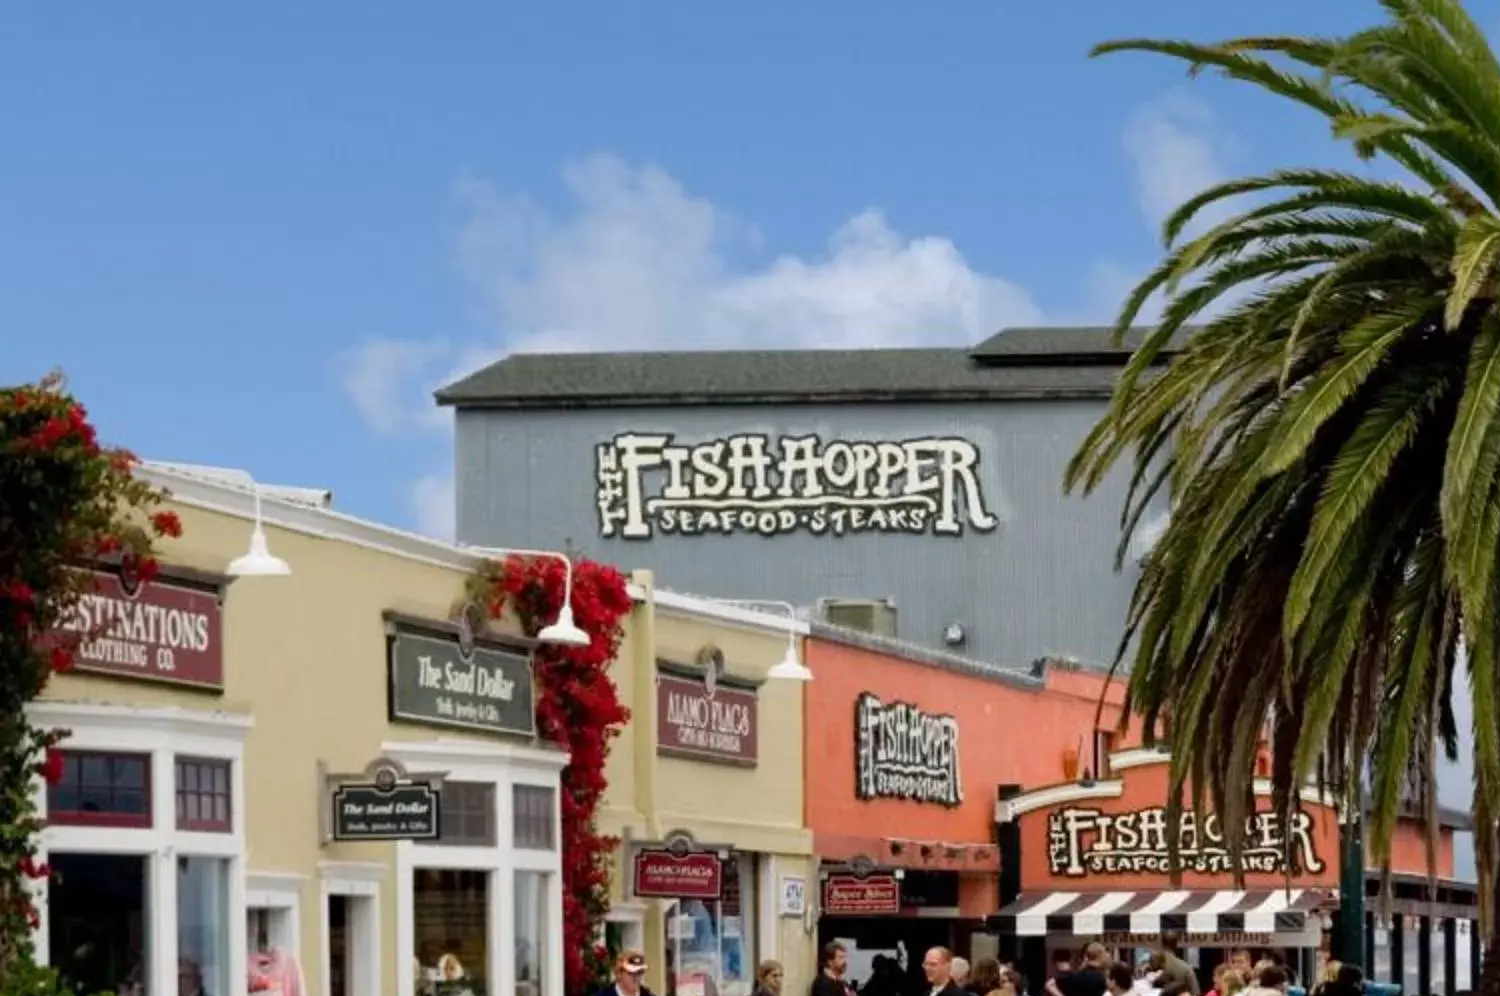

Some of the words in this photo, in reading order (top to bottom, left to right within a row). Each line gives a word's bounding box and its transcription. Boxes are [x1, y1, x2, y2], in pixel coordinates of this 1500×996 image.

[598, 445, 626, 535] THE
[615, 434, 769, 536] FISH
[778, 436, 997, 533] HOPPER
[661, 508, 803, 534] SEAFOOD
[809, 505, 926, 533] STEAKS
[79, 636, 147, 668] CLOTHING
[417, 655, 441, 689] The
[444, 661, 475, 695] Sand
[477, 666, 515, 701] Dollar
[1049, 814, 1068, 873] THE
[1063, 809, 1167, 875] FISH
